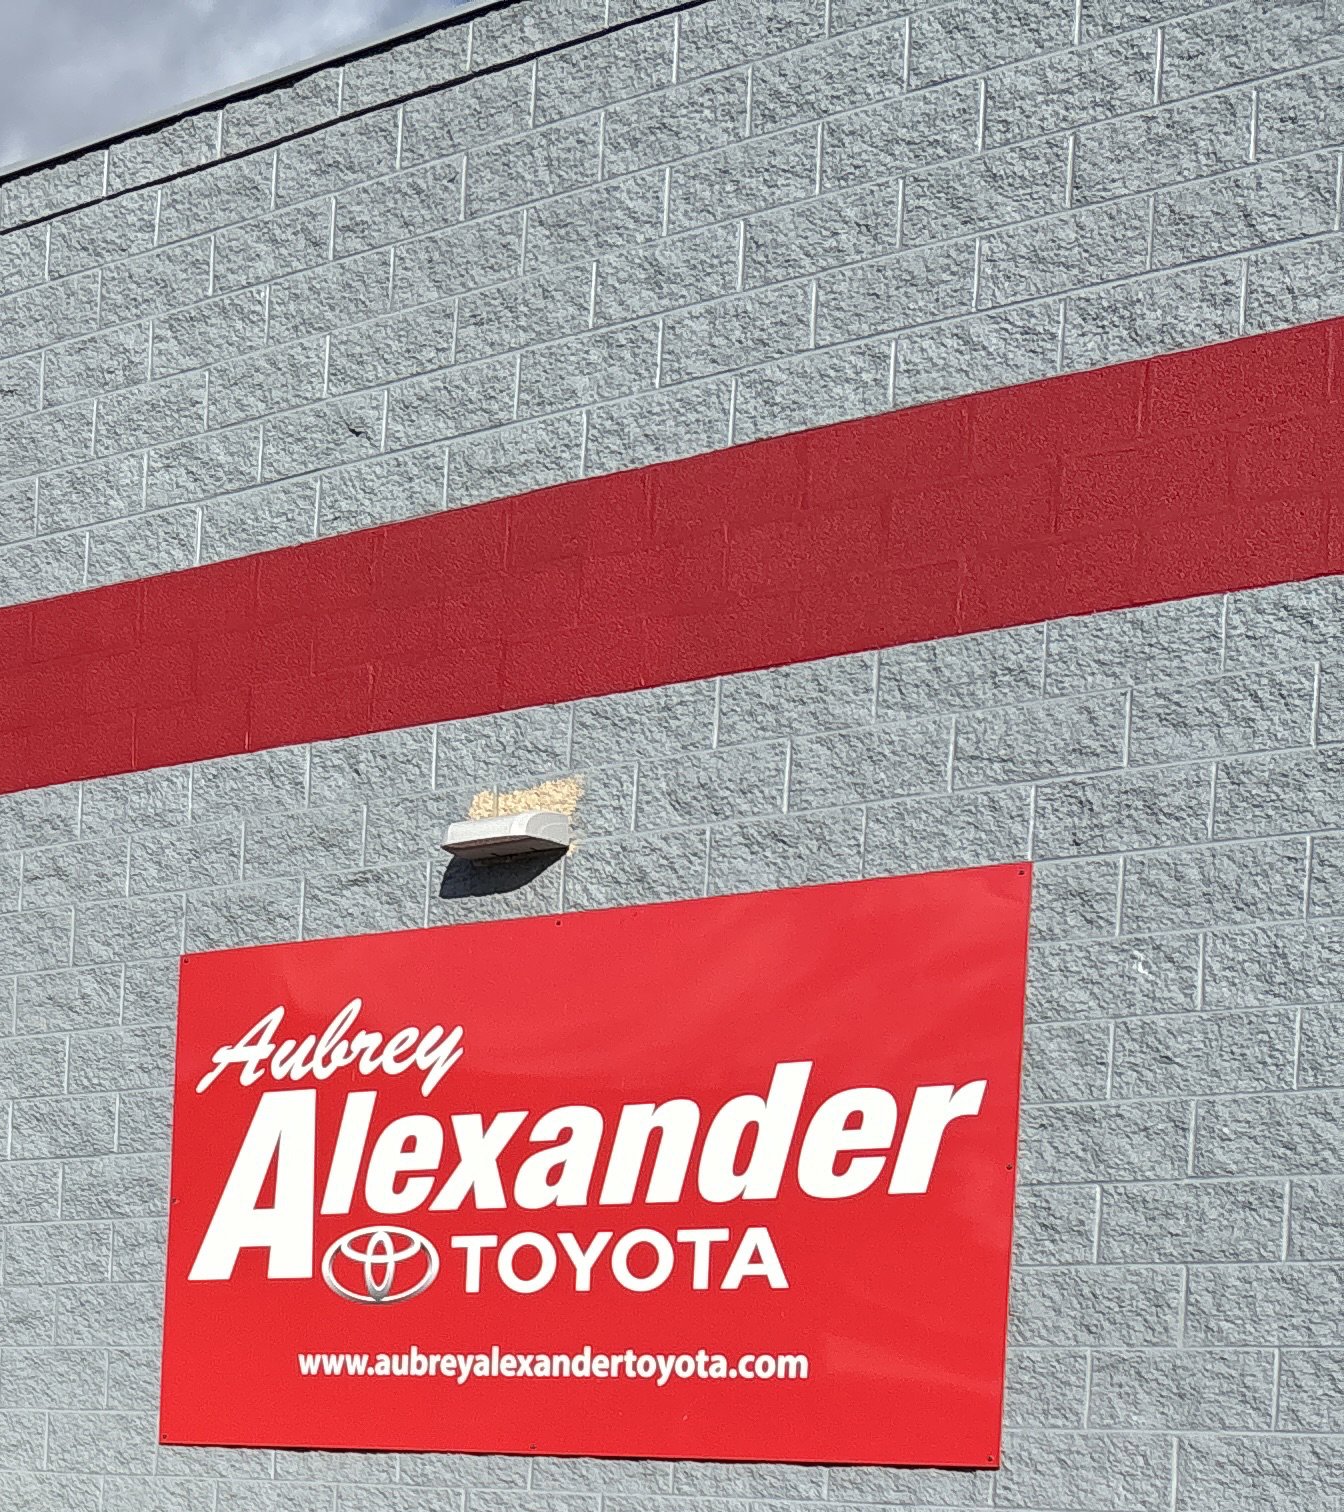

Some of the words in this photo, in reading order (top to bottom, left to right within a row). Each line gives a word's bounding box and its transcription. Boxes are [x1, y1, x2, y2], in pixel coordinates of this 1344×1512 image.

[195, 998, 464, 1098] Aubrey
[188, 1061, 988, 1281] Alexander
[450, 1227, 789, 1294] TOYOTA
[298, 1345, 809, 1387] www.aubreyalexandertoyota.com
